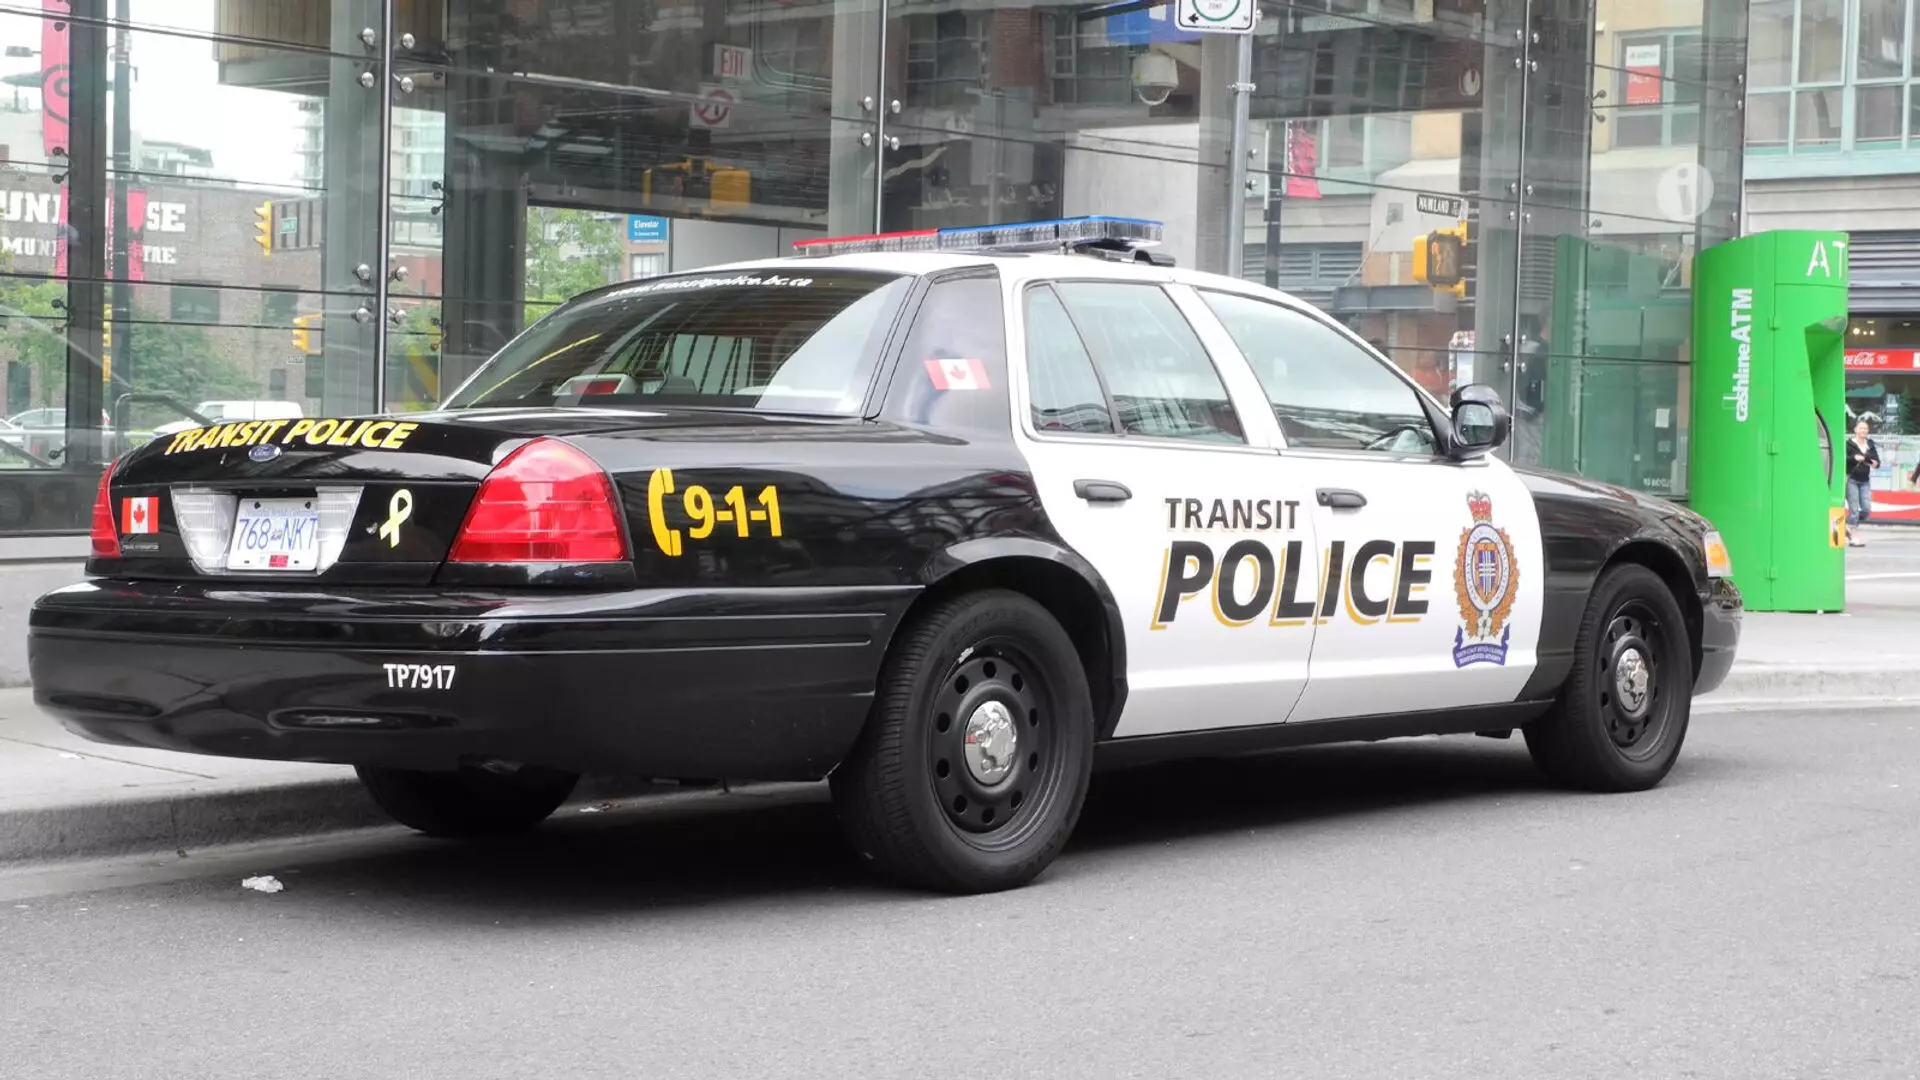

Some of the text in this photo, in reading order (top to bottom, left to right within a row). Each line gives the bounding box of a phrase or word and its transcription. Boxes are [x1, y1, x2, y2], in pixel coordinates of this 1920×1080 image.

[721, 47, 744, 76] EXIT
[165, 419, 419, 455] TRANSIT POLICE
[683, 485, 782, 538] 9-1-1
[1165, 498, 1300, 530] TRANSIT
[237, 517, 318, 550] 768 NKT
[1151, 539, 1435, 630] POLICE
[383, 663, 456, 690] TP7917
